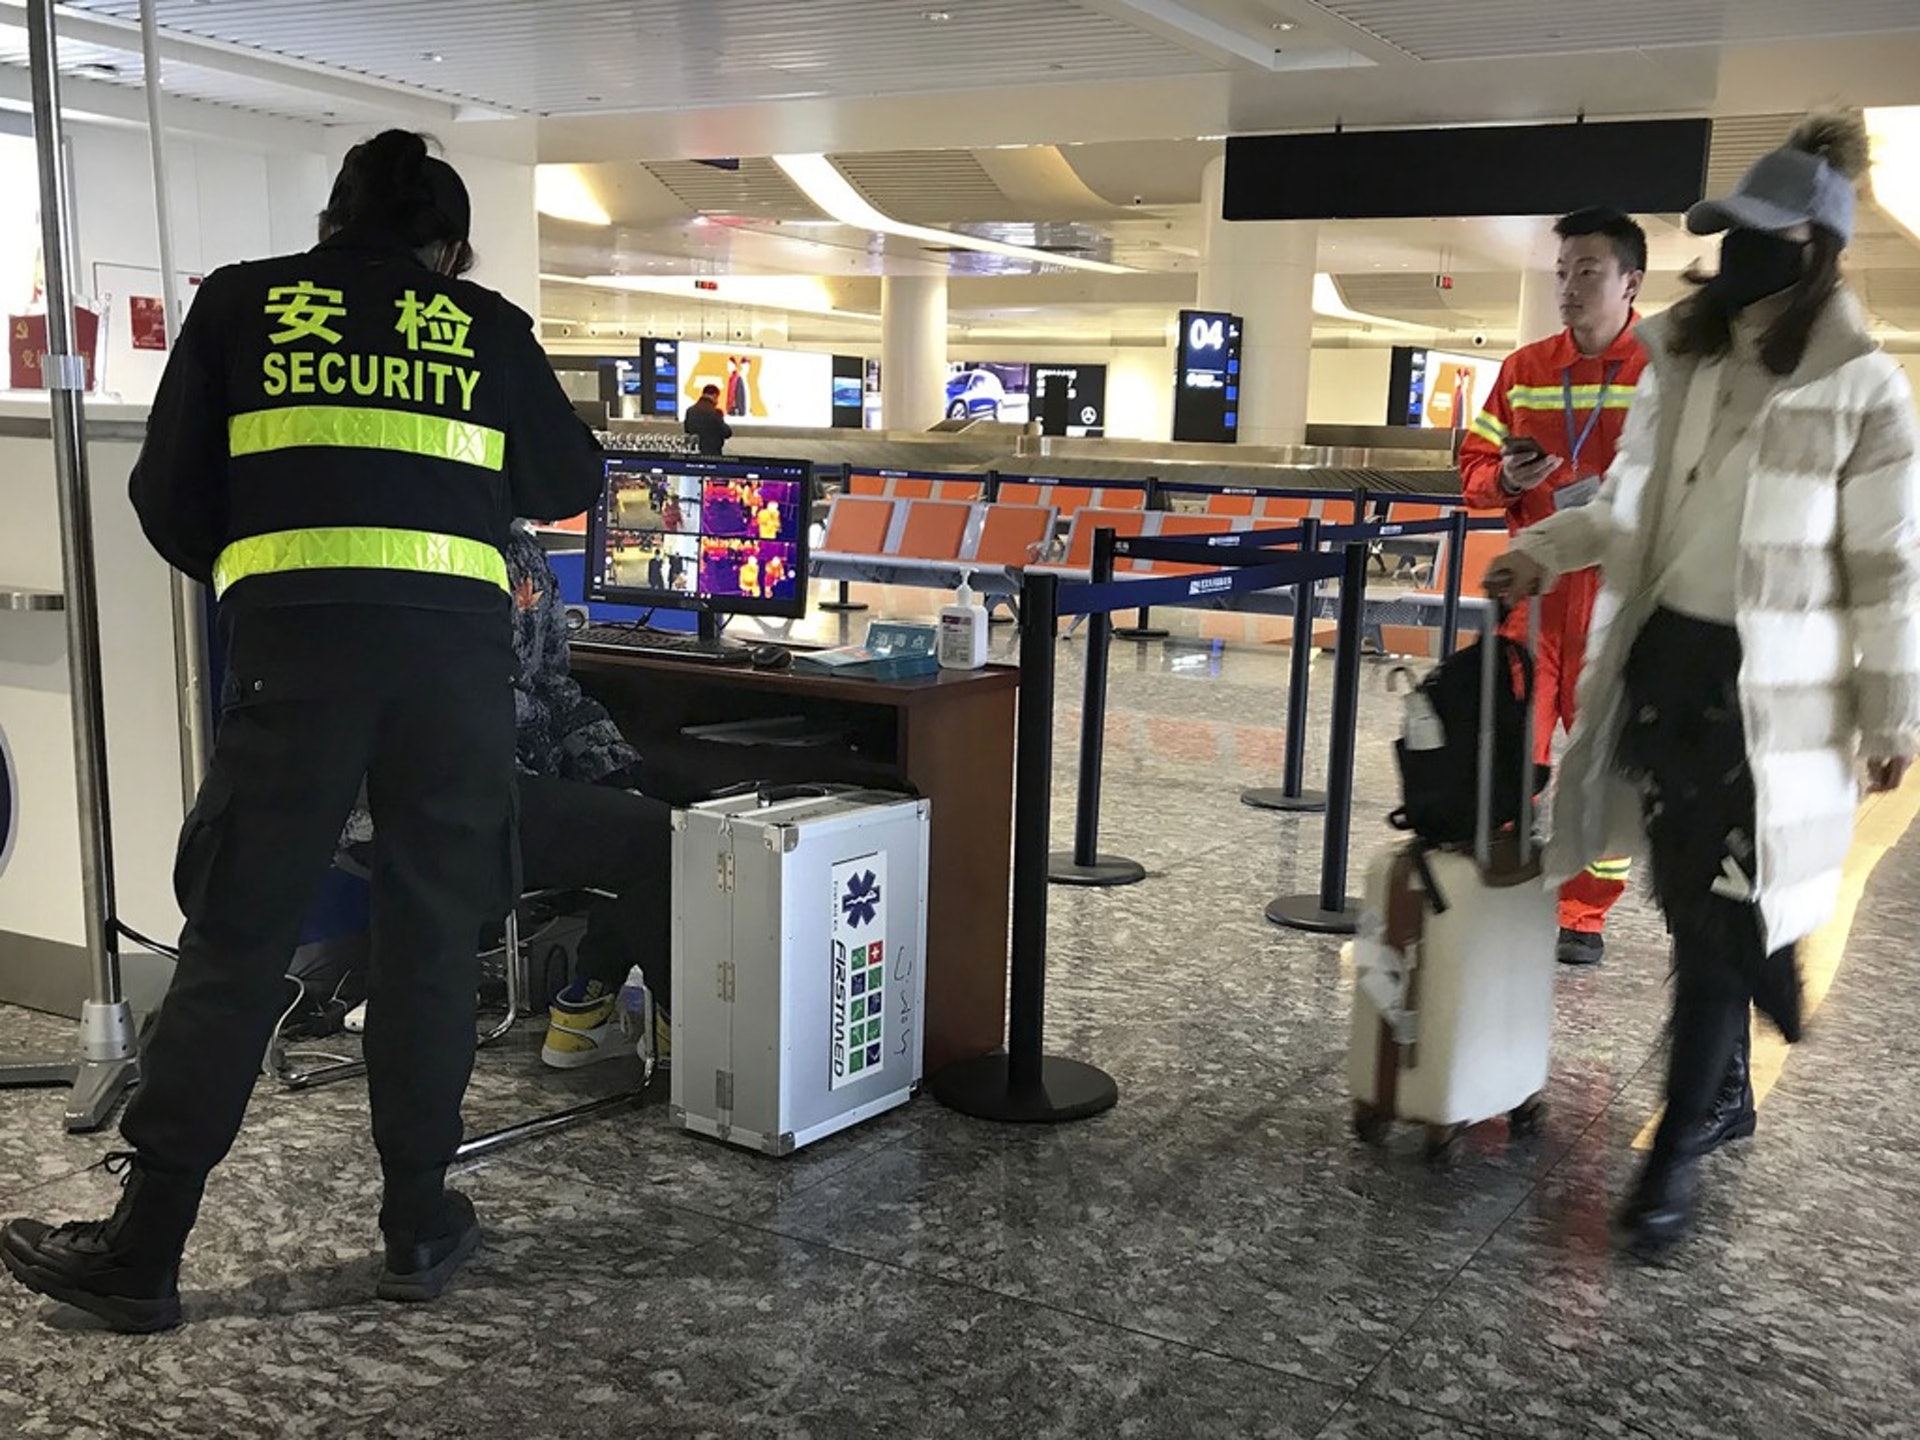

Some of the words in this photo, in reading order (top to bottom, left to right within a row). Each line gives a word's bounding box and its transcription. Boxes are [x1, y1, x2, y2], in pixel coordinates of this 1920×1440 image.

[264, 280, 475, 358] 安检
[1190, 318, 1224, 350] 04
[263, 352, 480, 411] SECURITY
[834, 939, 847, 1078] FIRSTMED
